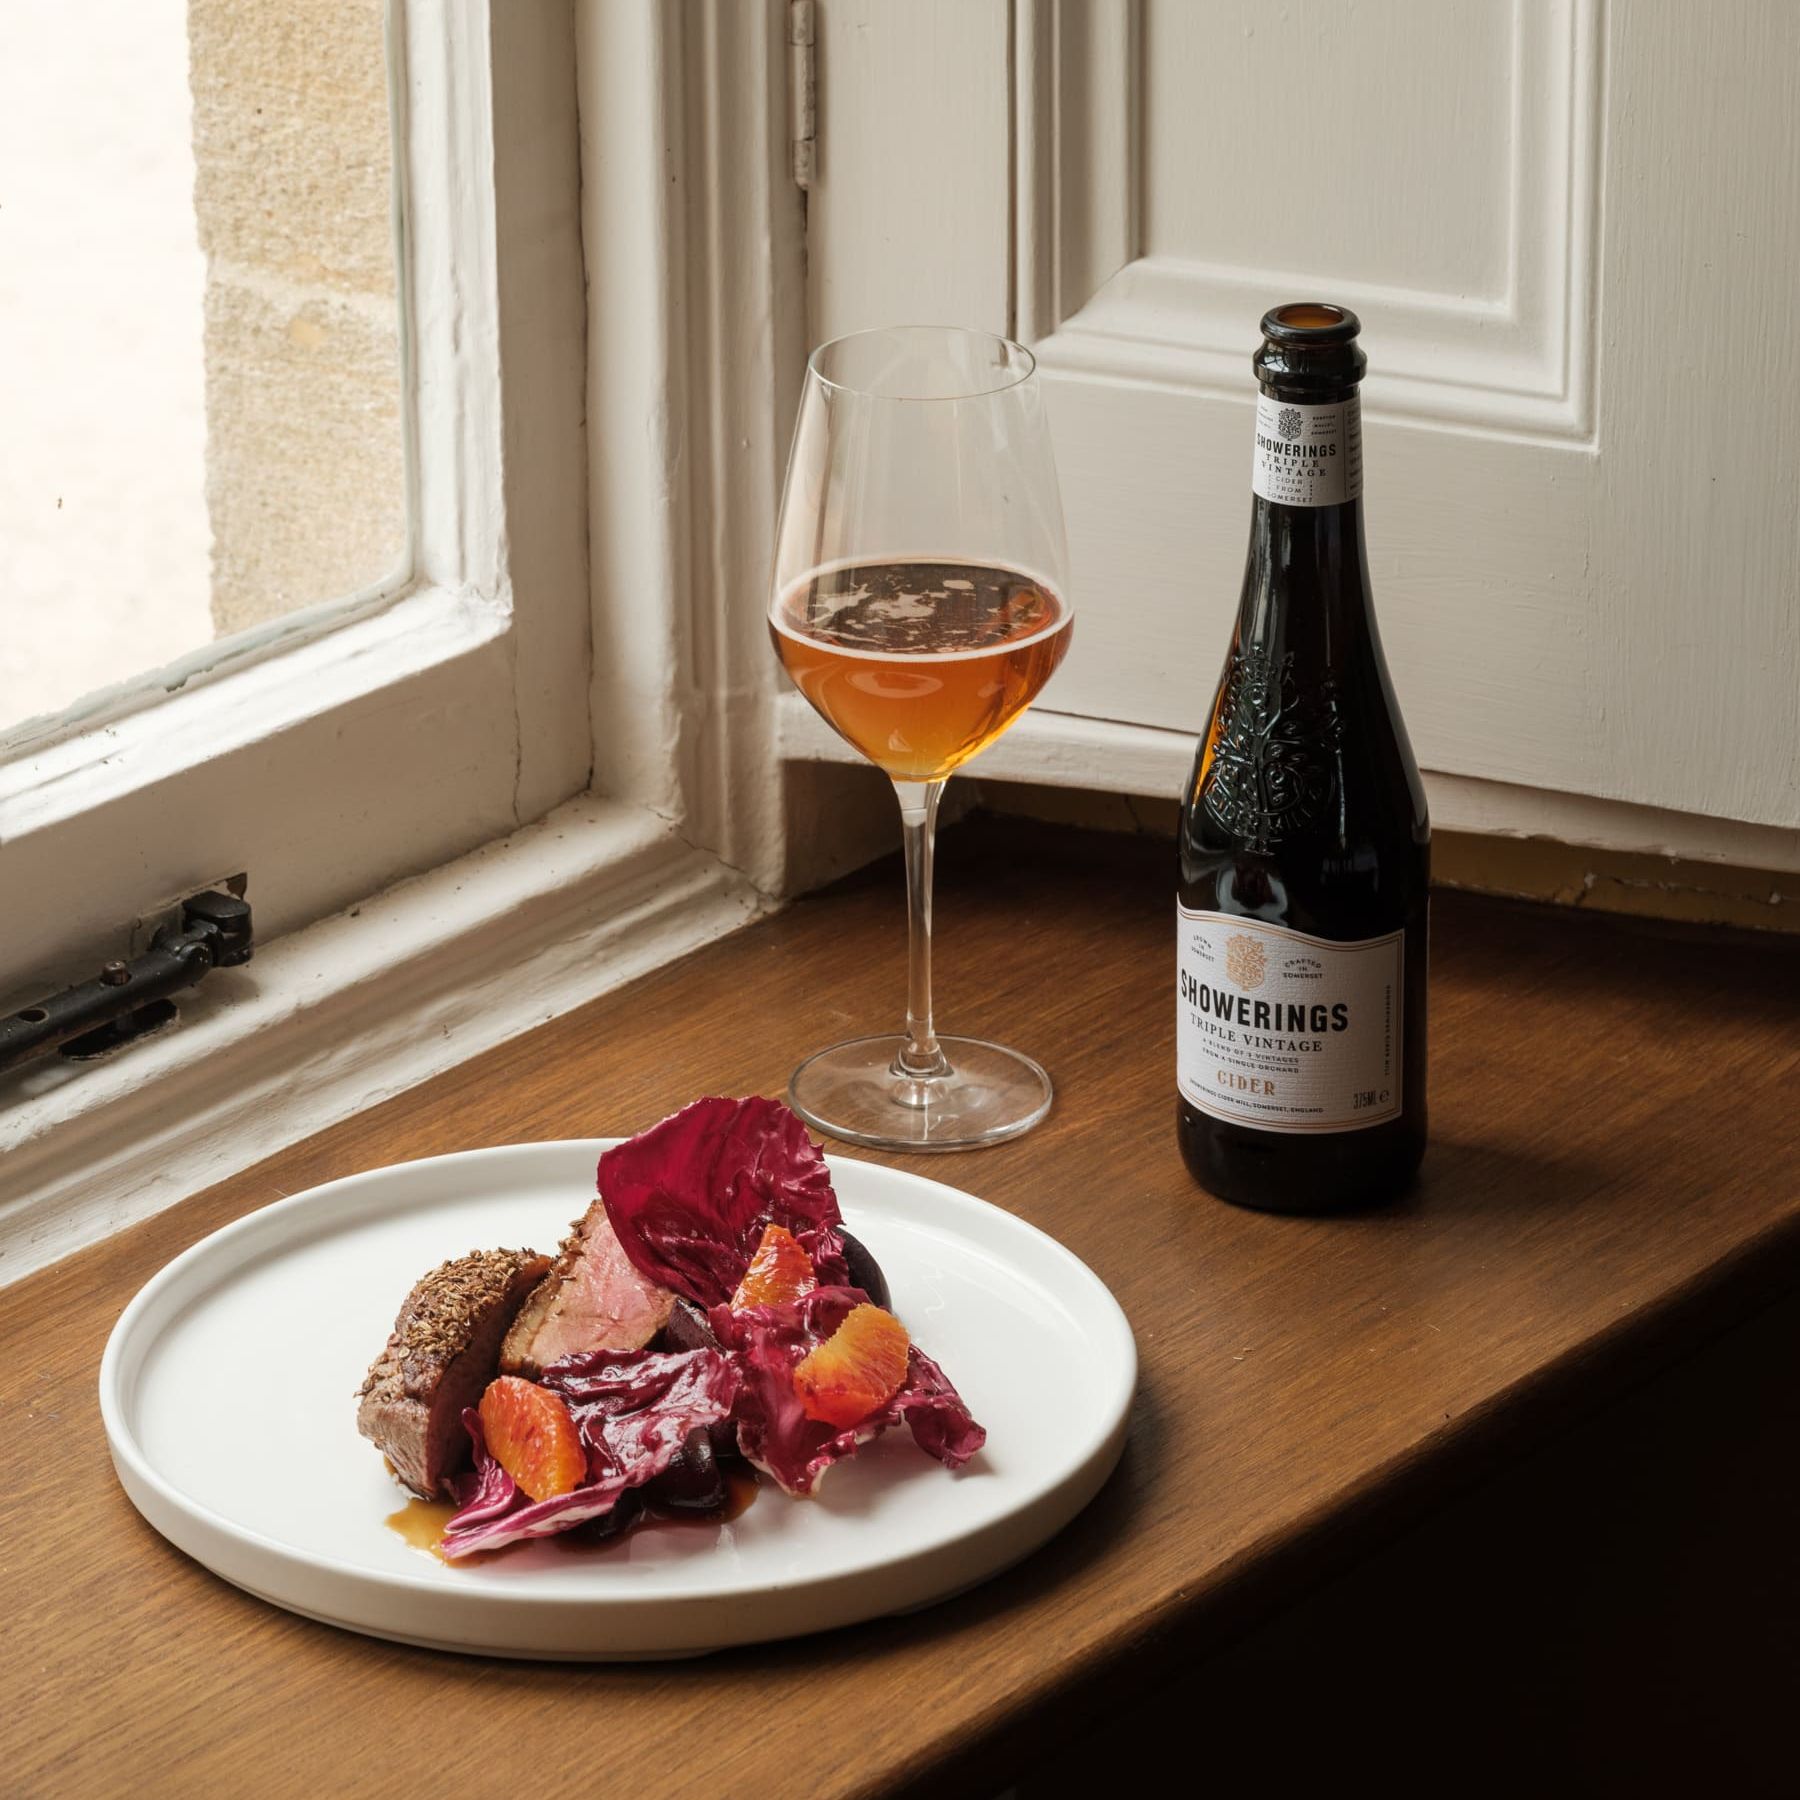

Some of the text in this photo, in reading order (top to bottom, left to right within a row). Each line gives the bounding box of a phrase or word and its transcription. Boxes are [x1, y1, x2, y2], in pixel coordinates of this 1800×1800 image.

[1257, 433, 1337, 458] SHOWERINGS
[1262, 460, 1326, 477] VINTAGE
[1266, 453, 1320, 468] TRIPLE
[1275, 476, 1303, 485] CIDER
[1284, 958, 1322, 969] CRAFTED
[1181, 968, 1348, 1033] SHOWERINGS
[1190, 1012, 1322, 1052] TRIPLE VINTAGE
[1255, 1053, 1299, 1064] VINTAGES
[1217, 1070, 1275, 1095] CIDER
